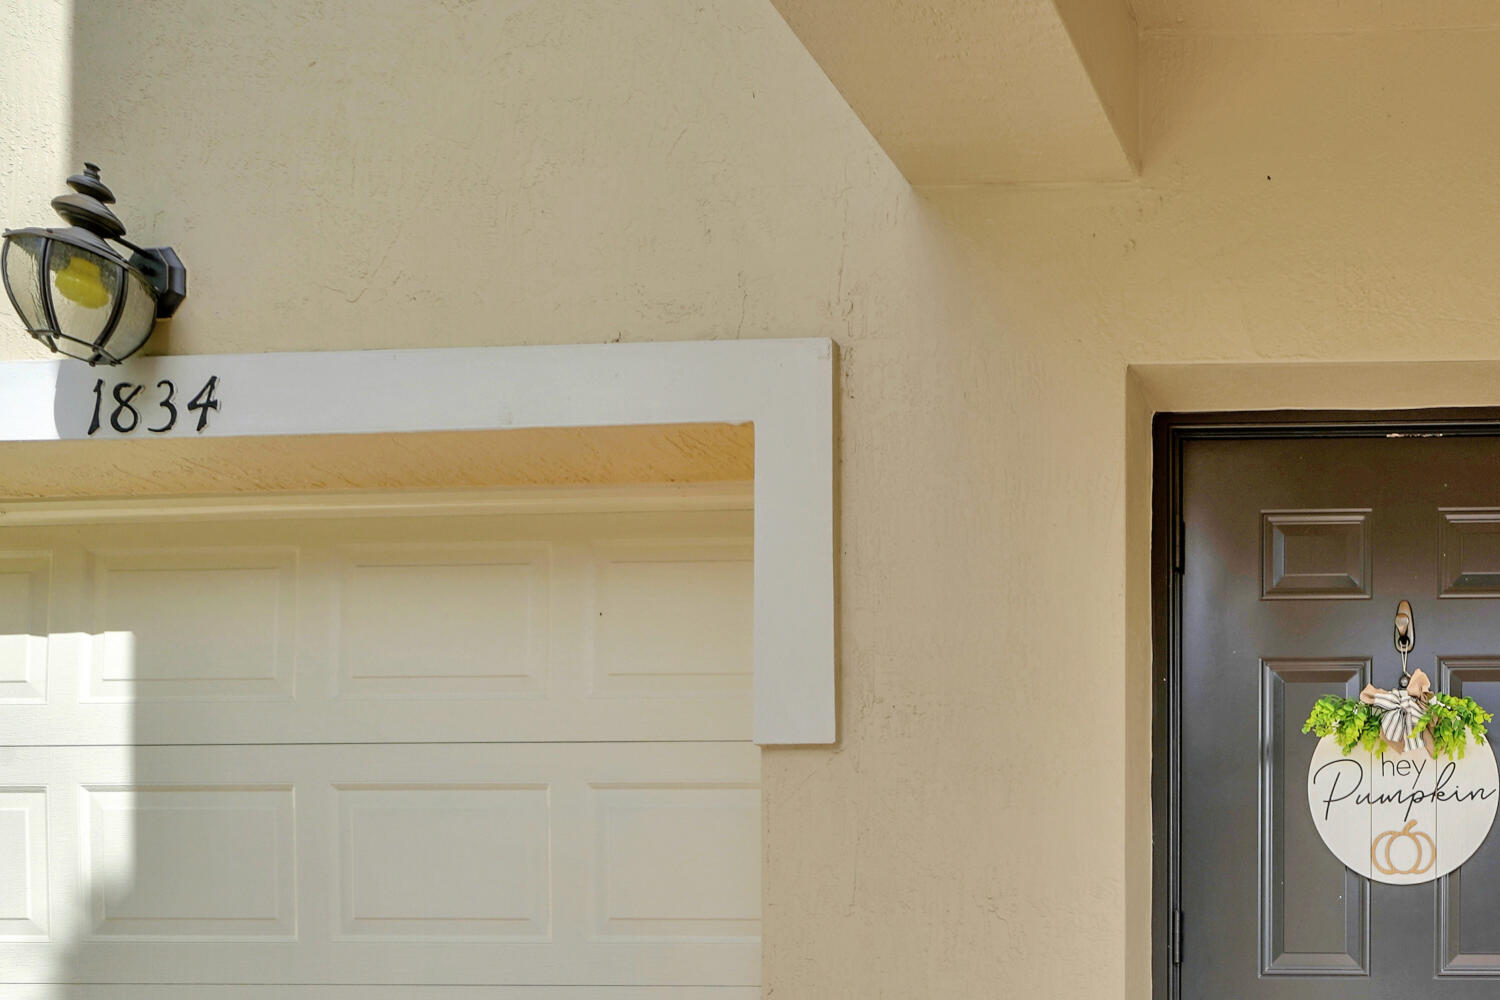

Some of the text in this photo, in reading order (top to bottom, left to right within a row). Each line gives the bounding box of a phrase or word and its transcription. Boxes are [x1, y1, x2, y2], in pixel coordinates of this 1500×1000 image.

[88, 376, 218, 435] 1834
[1313, 759, 1496, 822] Pumpkin
[1381, 752, 1426, 790] hey
